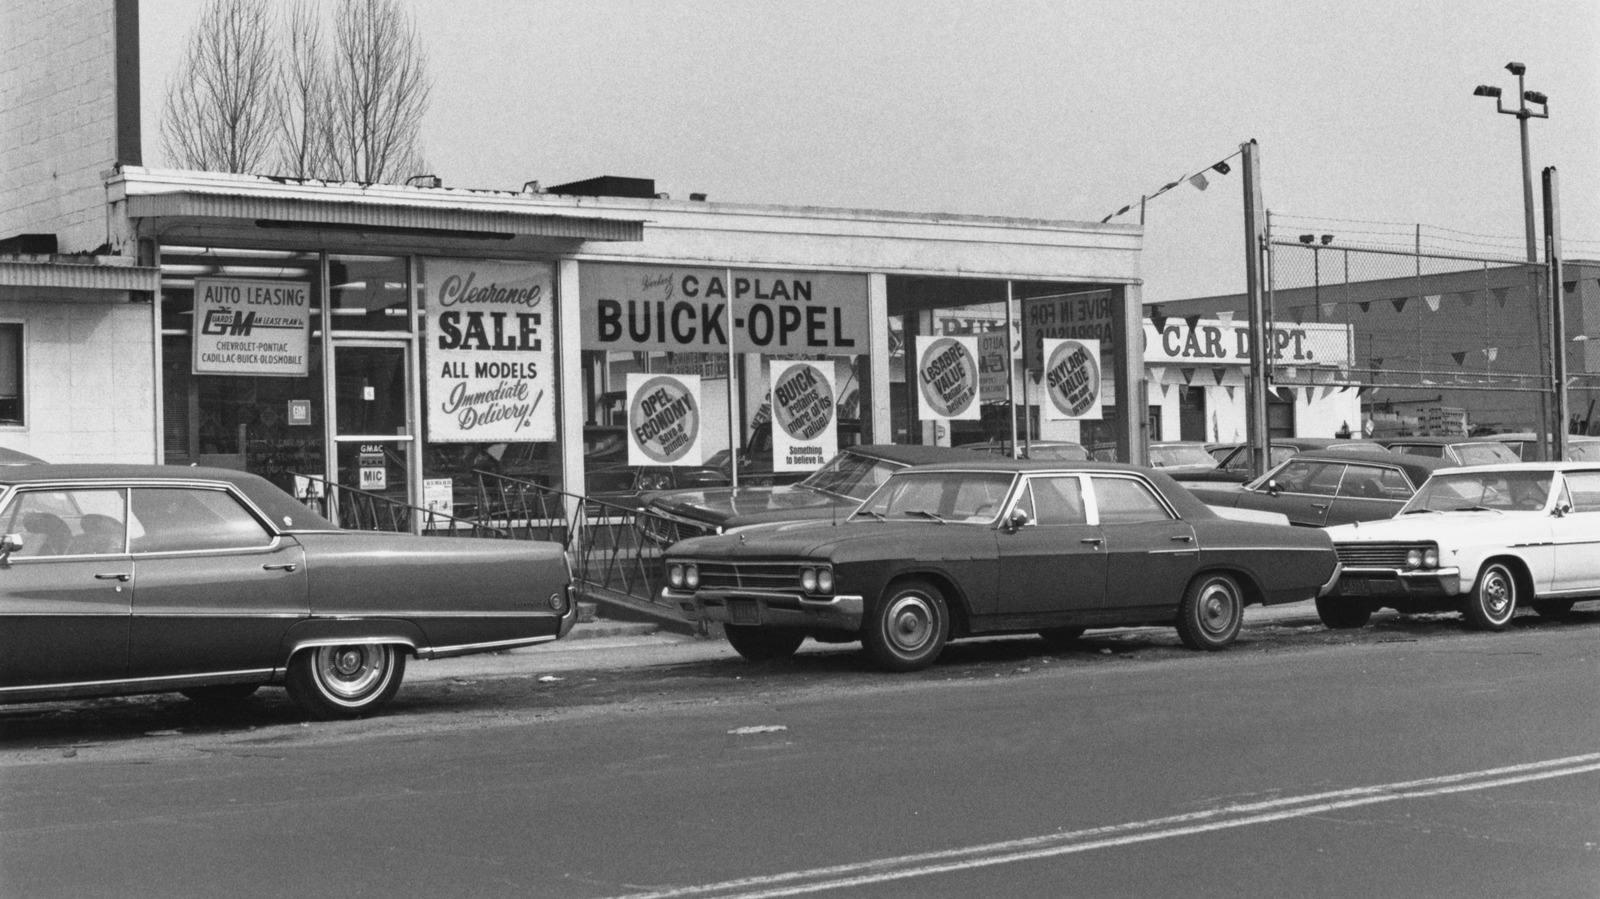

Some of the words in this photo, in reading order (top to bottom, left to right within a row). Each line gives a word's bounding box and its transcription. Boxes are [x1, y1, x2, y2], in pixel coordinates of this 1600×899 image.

[204, 286, 241, 304] AUTO
[247, 287, 305, 306] LEASING
[438, 271, 542, 307] Clearance
[681, 275, 812, 300] CAPLAN
[438, 311, 542, 351] SALE
[1162, 326, 1227, 358] CAR
[441, 361, 469, 378] ALL
[475, 362, 537, 379] MODELS
[921, 341, 965, 385] LeSABRE
[933, 361, 966, 396] VALUE
[1047, 346, 1089, 388] SKYLARK
[442, 379, 529, 414] Immediate
[775, 366, 818, 407] BUICK
[1059, 366, 1089, 399] VALUE
[458, 389, 544, 433] Delivery!
[641, 387, 673, 418] OPEL
[787, 411, 812, 435] more
[810, 401, 821, 418] of
[819, 395, 832, 412] its
[788, 389, 819, 417] retains
[635, 393, 692, 445] ECONOMY
[677, 423, 684, 433] a
[802, 413, 829, 440] value!
[360, 444, 384, 453] GMAC
[663, 433, 690, 456] bundle
[786, 456, 793, 465] to
[794, 455, 817, 465] believe
[789, 445, 823, 456] Something
[363, 470, 383, 482] MIC
